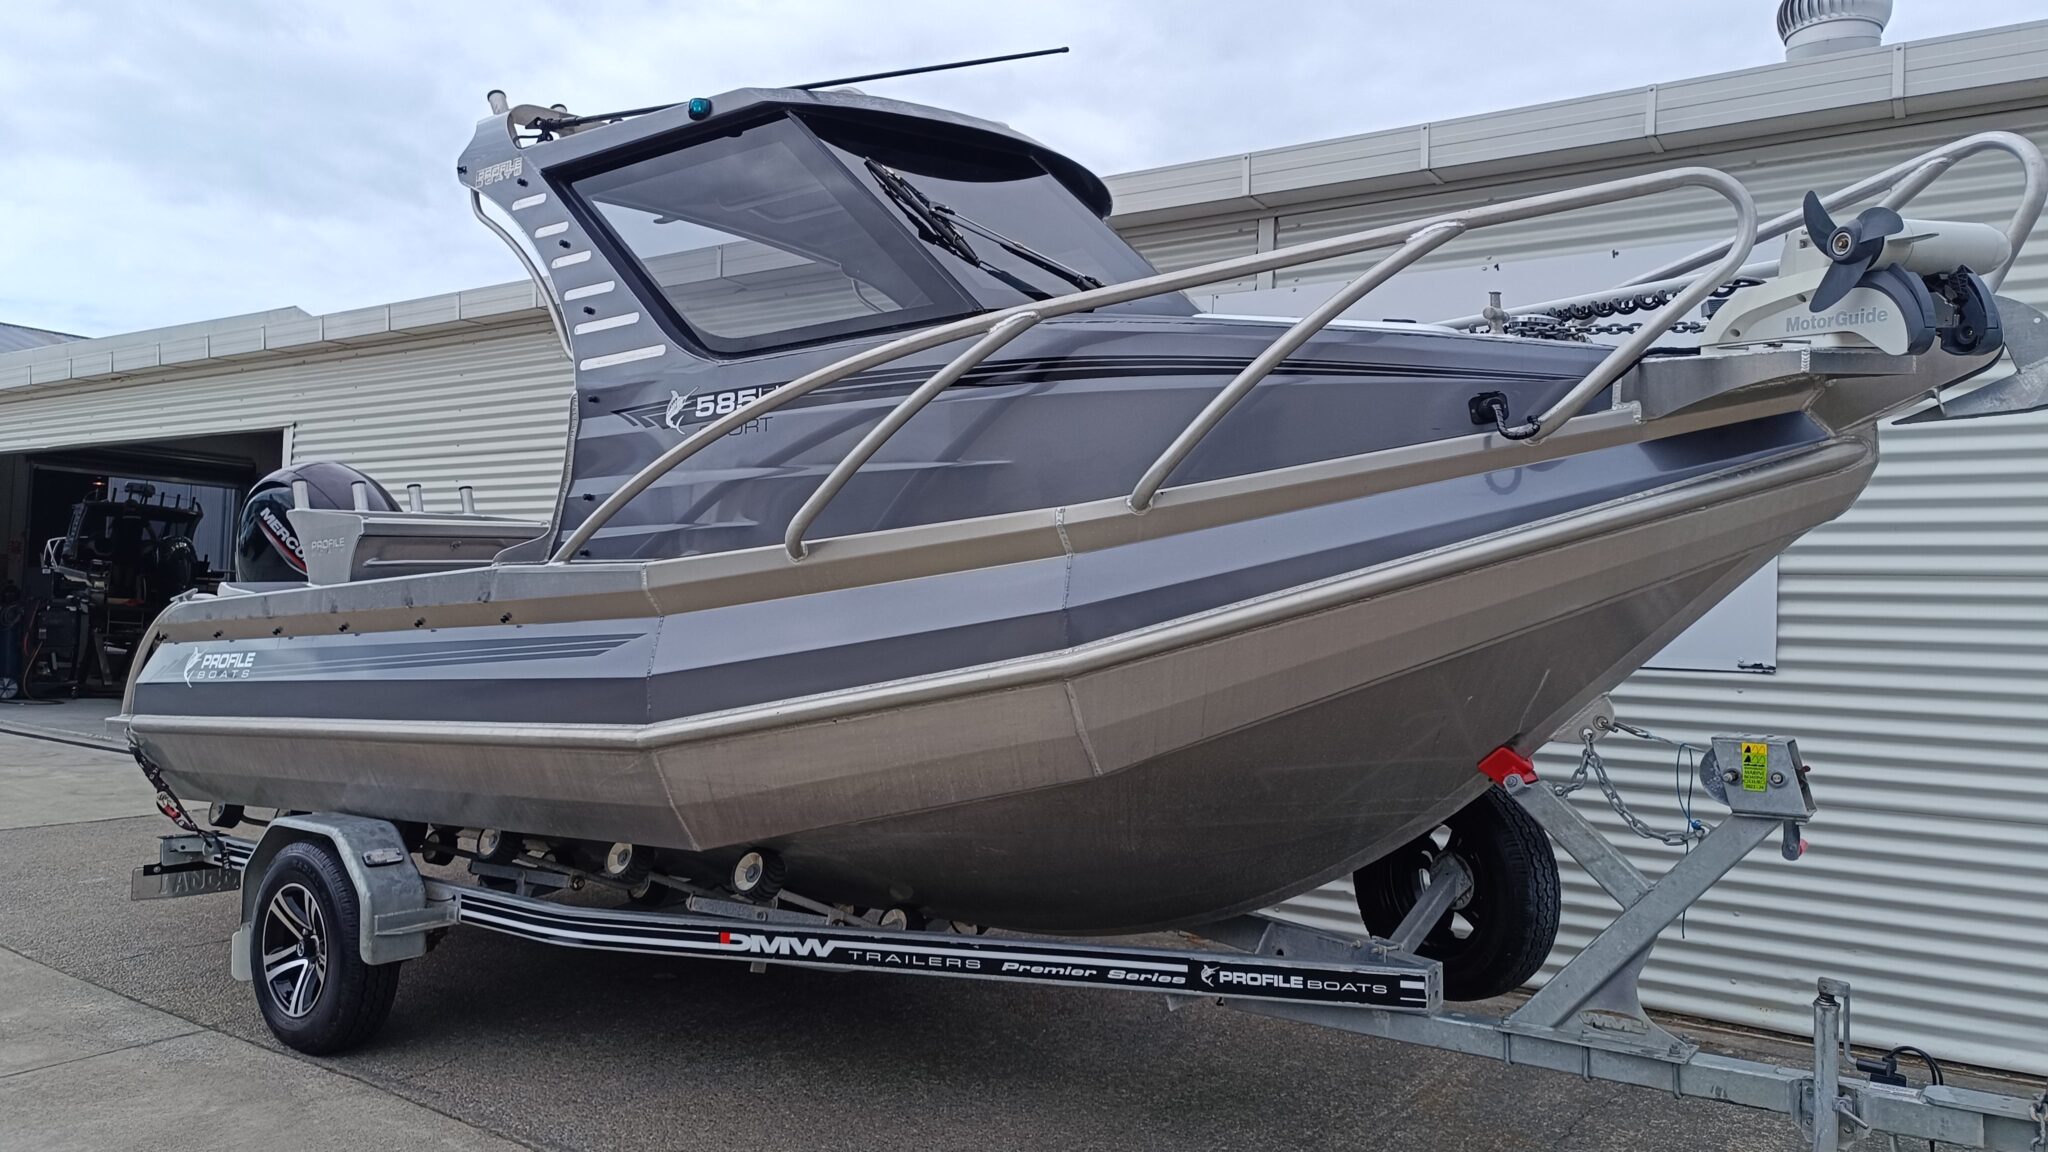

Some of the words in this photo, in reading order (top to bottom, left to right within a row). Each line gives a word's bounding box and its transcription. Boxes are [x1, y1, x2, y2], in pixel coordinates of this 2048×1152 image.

[1786, 307, 1888, 333] MotorGuide
[311, 537, 345, 550] PROFILE
[201, 652, 256, 669] PROFILE
[198, 669, 250, 679] BOATS
[720, 931, 838, 958] DMW
[848, 950, 981, 970] TRAILERS
[1001, 961, 1097, 977] Premier
[1107, 969, 1187, 984] Series
[1219, 970, 1304, 989] PROFILE
[1307, 979, 1388, 994] BOATS
